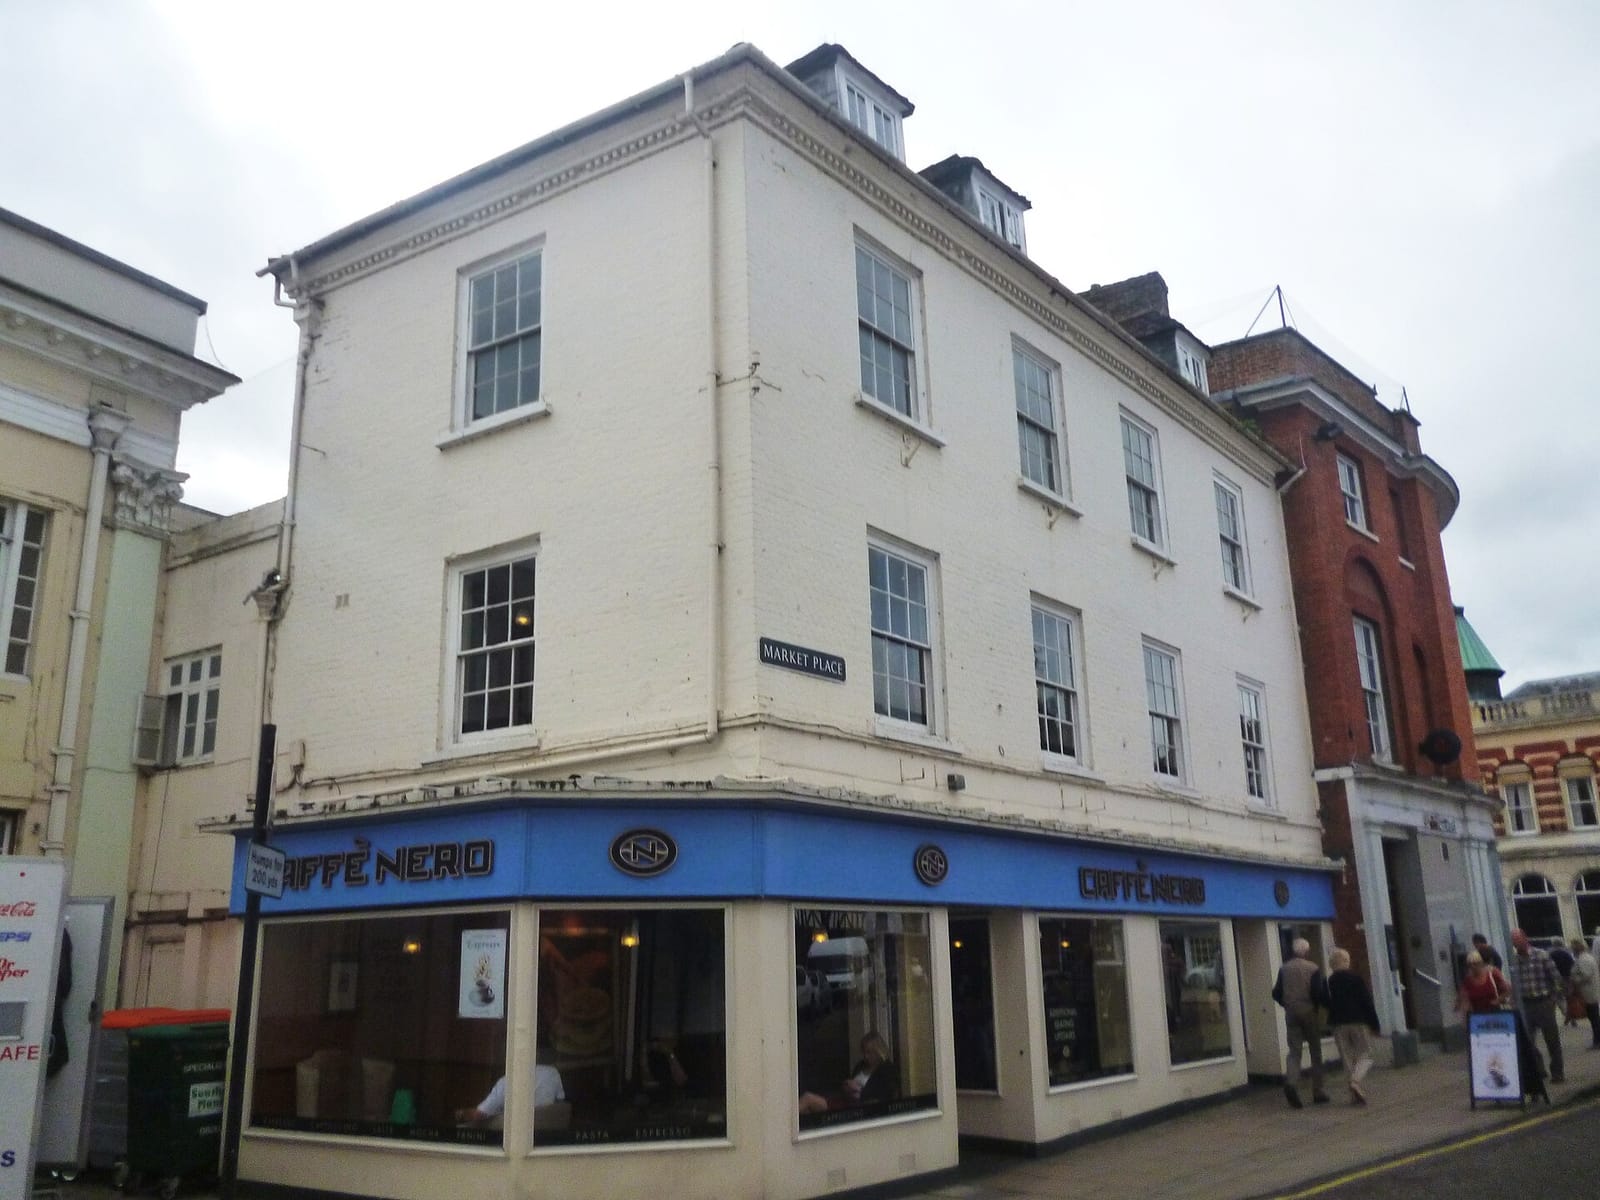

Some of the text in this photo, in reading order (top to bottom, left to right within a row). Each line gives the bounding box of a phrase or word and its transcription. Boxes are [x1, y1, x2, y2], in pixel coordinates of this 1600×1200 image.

[764, 643, 842, 675] MARKET PLACE
[284, 838, 495, 890] AFFÈ NERO
[1149, 871, 1206, 905] NERO
[0, 931, 32, 942] EPSI
[1, 1045, 40, 1061] AFE
[1, 1151, 15, 1168] S
